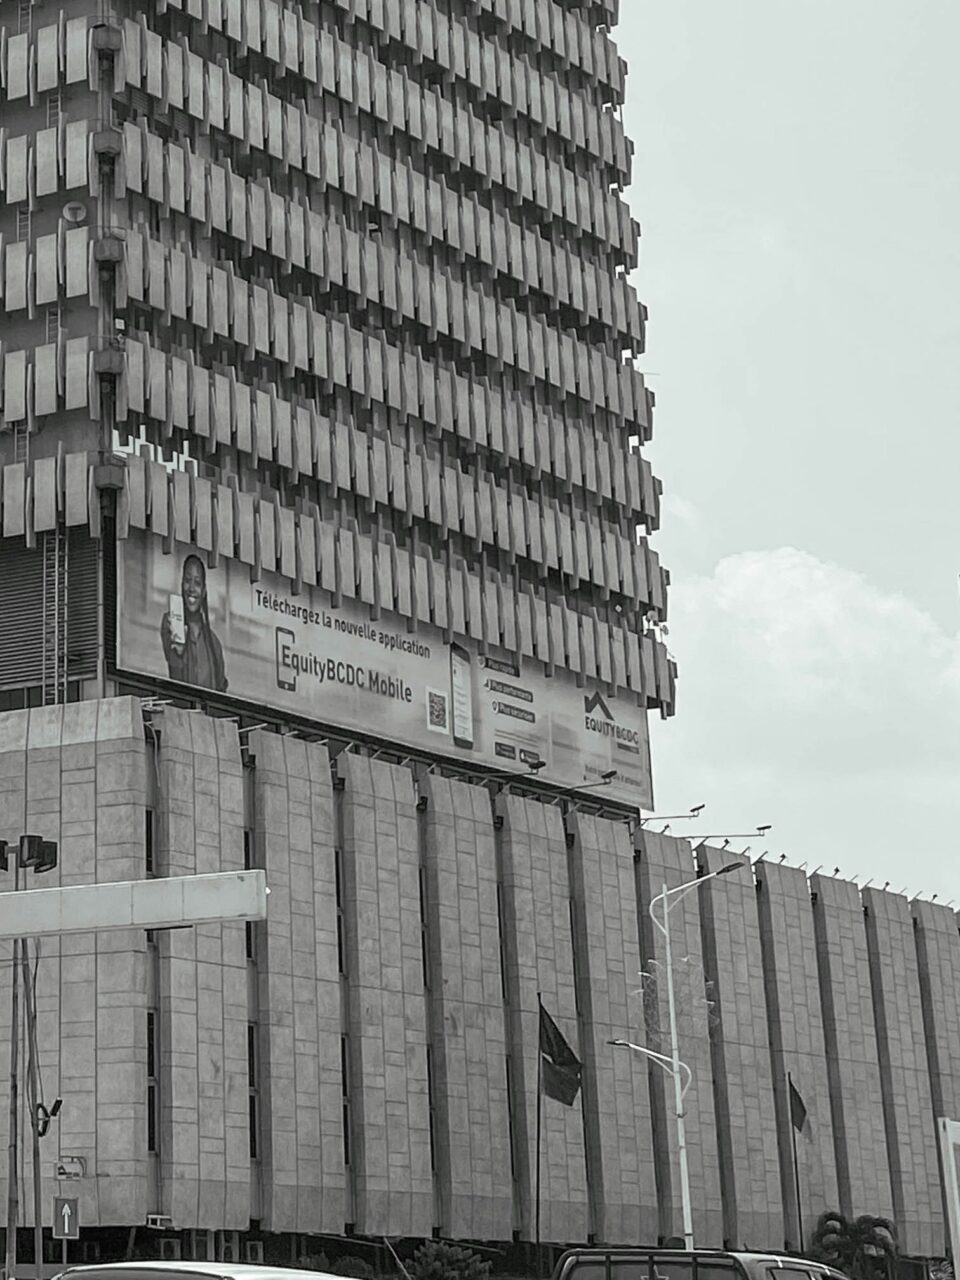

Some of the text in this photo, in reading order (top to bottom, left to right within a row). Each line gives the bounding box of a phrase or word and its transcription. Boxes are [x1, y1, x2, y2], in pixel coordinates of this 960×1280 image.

[255, 589, 431, 659] Téléchargez la nouvelle application
[281, 644, 413, 703] EquityBCDC Mobile
